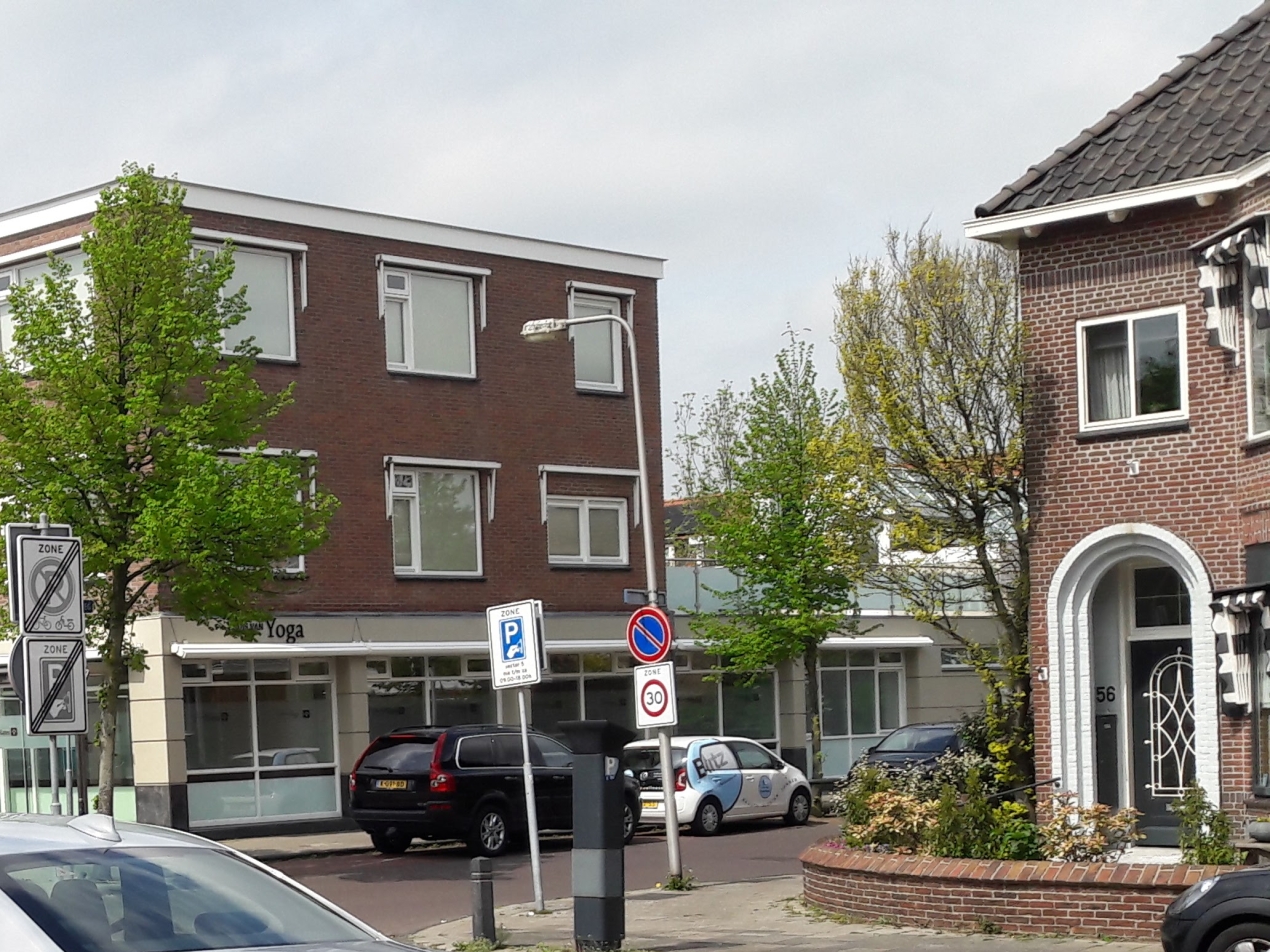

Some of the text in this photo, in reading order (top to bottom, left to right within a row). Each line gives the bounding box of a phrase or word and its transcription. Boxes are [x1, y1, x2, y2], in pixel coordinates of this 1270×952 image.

[38, 544, 64, 554] ZONE
[501, 608, 520, 618] ZONE
[266, 618, 304, 643] Yoga
[504, 621, 519, 644] P
[43, 645, 68, 654] ZONE
[644, 669, 662, 677] ZONE
[646, 690, 663, 705] 30
[1095, 685, 1116, 703] 56
[693, 751, 728, 780] Blitz
